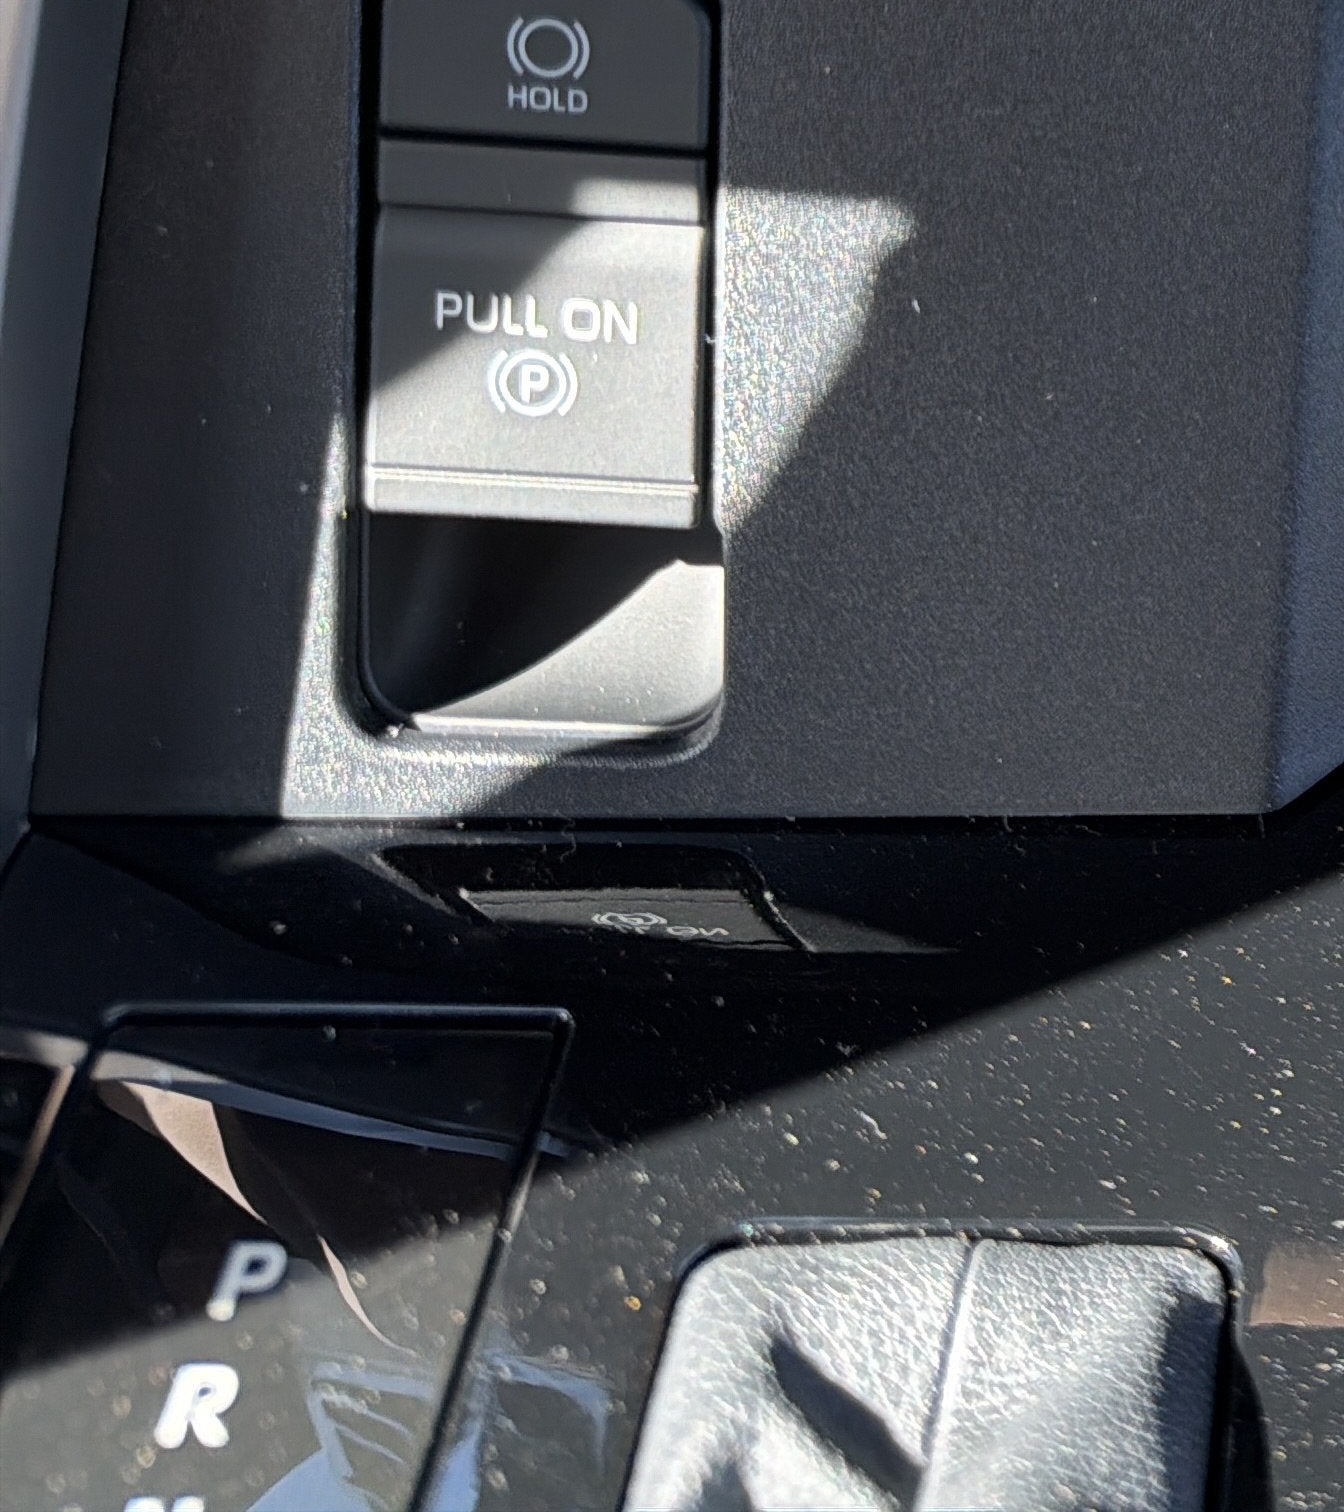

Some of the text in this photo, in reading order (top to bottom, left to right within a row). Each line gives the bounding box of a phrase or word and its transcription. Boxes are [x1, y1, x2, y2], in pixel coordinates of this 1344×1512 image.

[507, 85, 589, 114] HOLD
[434, 291, 640, 345] PULL ON
[206, 1241, 289, 1322] P
[153, 1362, 240, 1449] R
